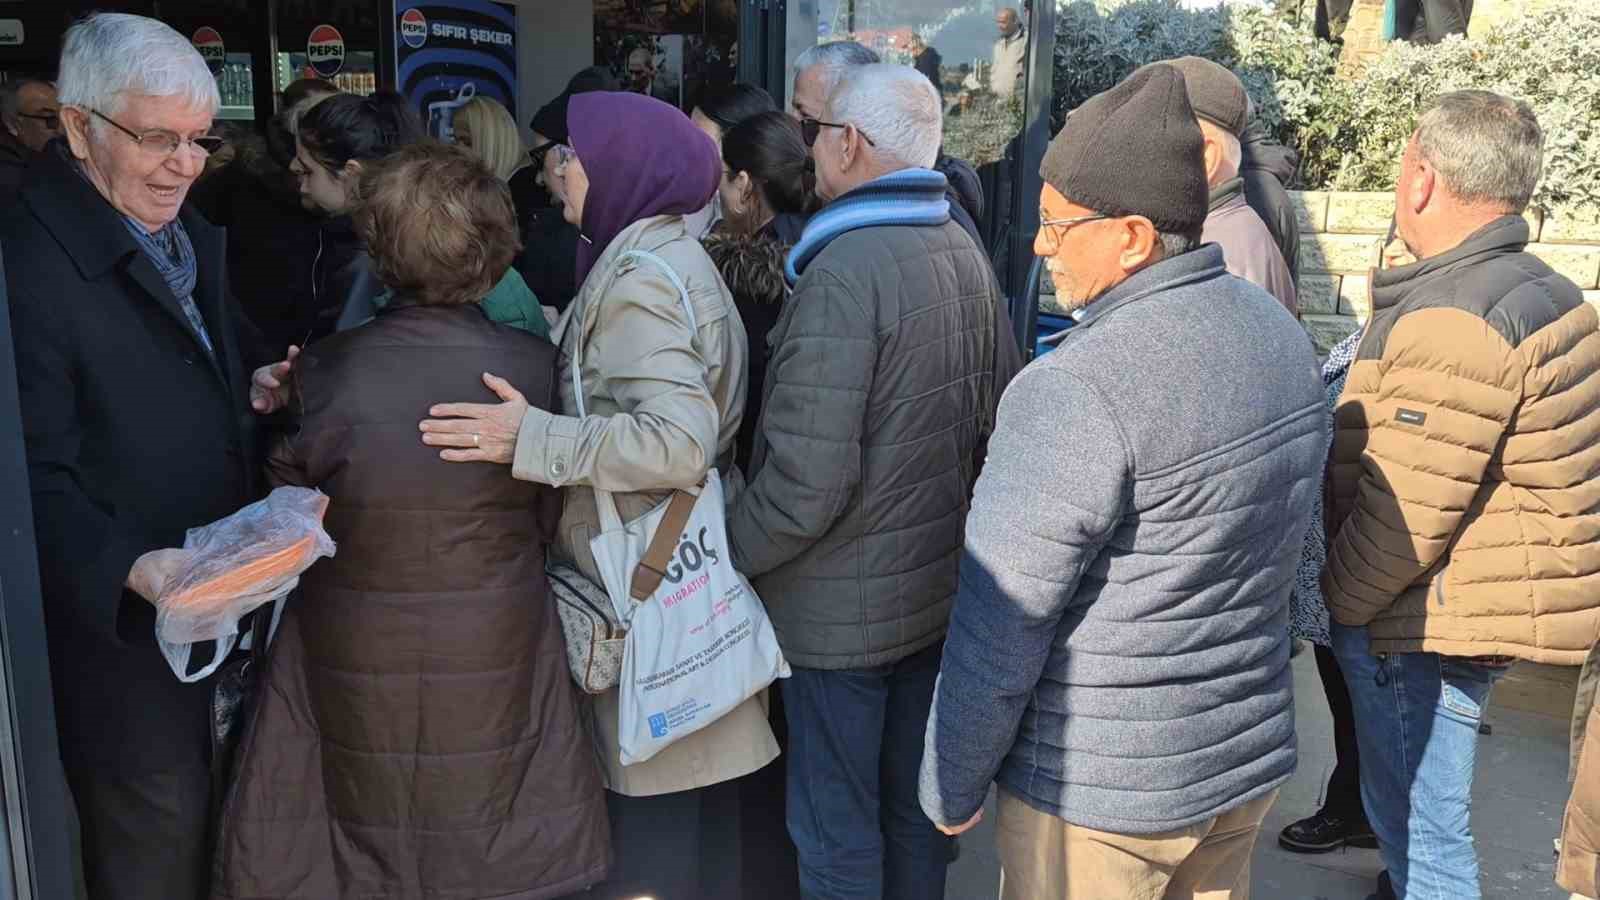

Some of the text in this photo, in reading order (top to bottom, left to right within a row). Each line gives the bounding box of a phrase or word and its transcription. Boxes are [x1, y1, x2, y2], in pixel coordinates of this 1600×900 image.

[403, 23, 426, 32] PEPSI
[432, 23, 513, 45] SIFIR ŞEKER
[198, 47, 223, 57] EPSI
[310, 45, 343, 56] PEPSI
